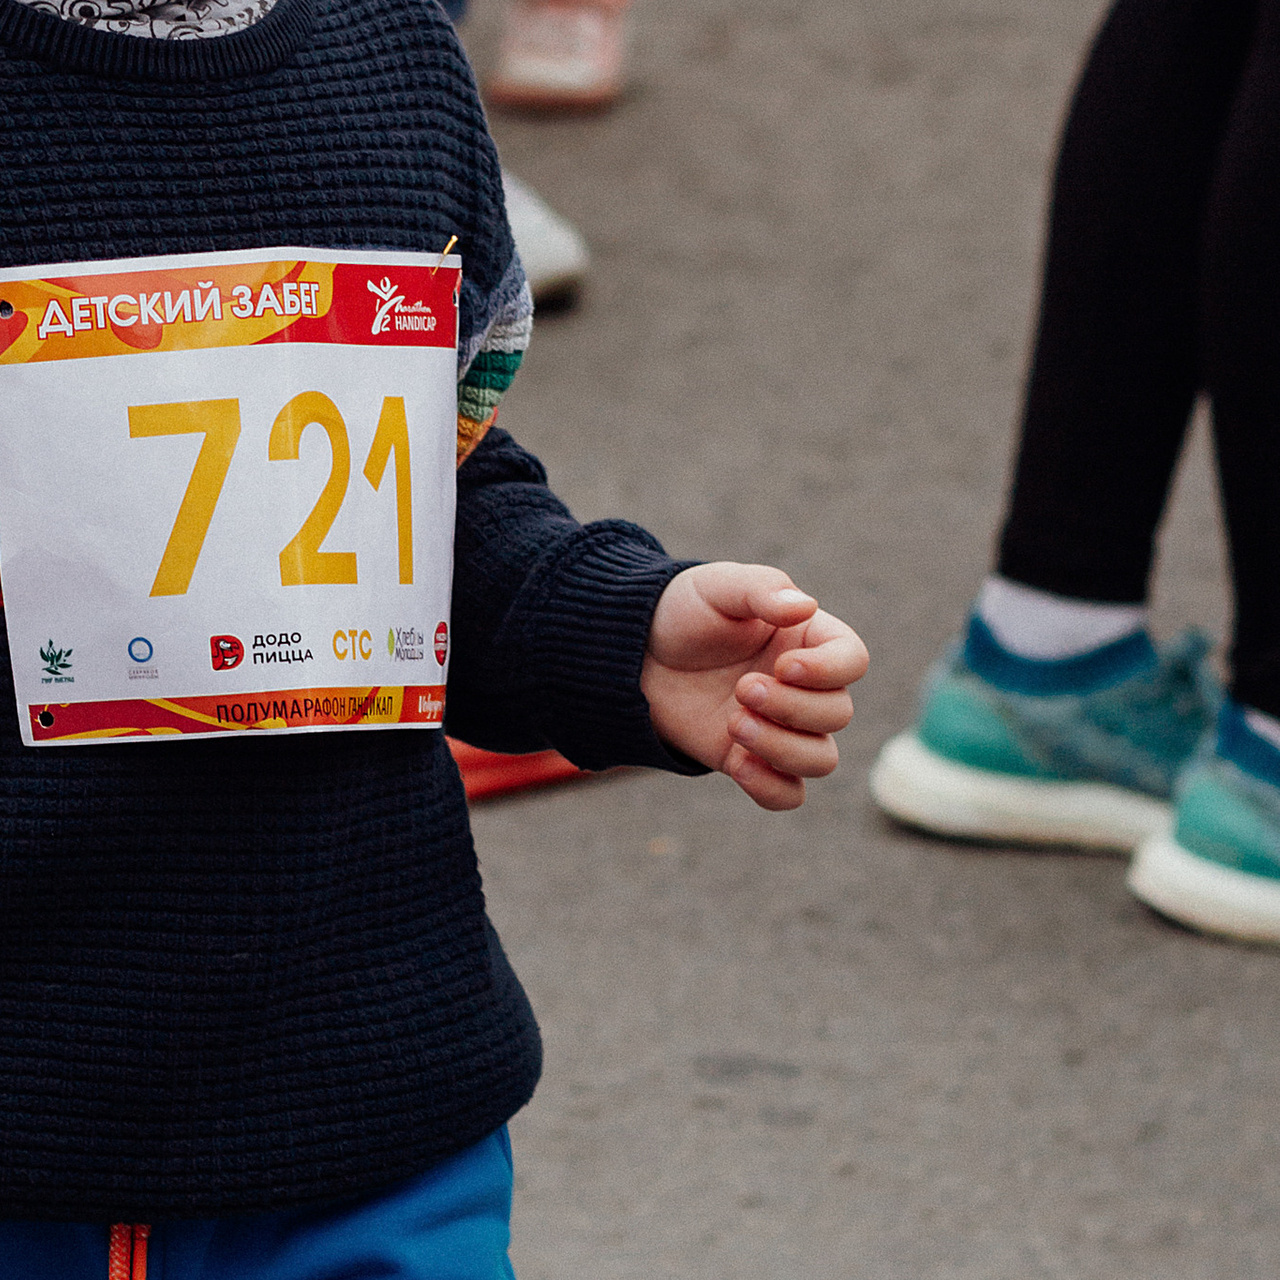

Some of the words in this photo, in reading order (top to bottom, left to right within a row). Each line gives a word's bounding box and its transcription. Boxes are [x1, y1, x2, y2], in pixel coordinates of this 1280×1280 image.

[38, 280, 223, 340] ДЕТСКИЙ
[230, 282, 320, 319] ЗАБЕГ
[394, 315, 437, 332] HANDICAP
[127, 390, 414, 598] 721
[252, 632, 302, 649] ДОДО
[332, 629, 373, 661] СТС
[252, 649, 314, 665] ПИЦЦА
[216, 696, 346, 724] ПОЛУМАРАФОН
[347, 696, 394, 718] ГАНДИКАП
